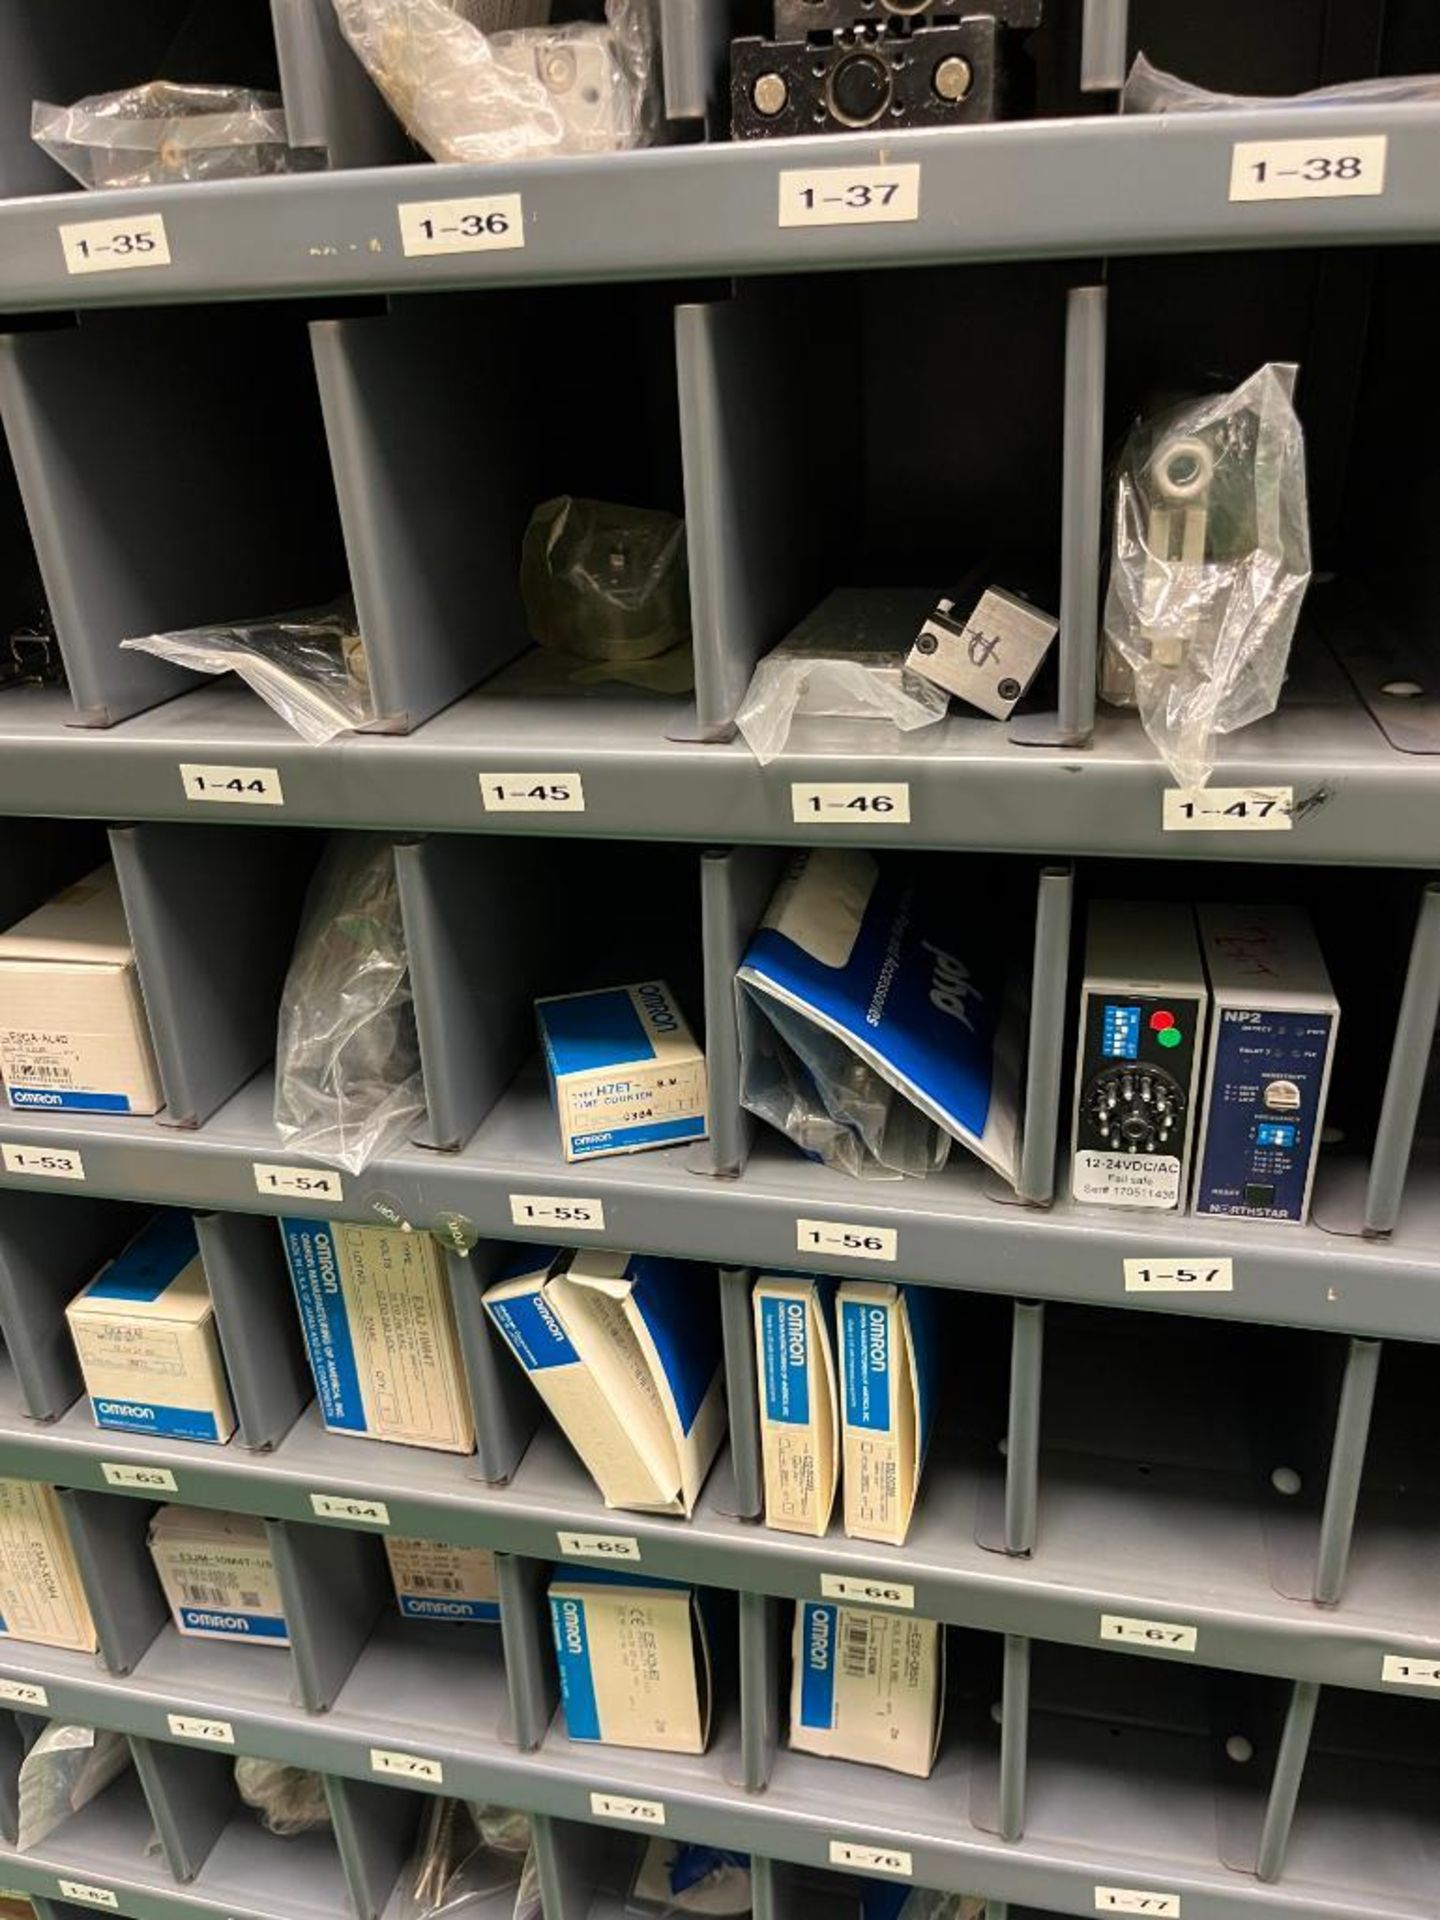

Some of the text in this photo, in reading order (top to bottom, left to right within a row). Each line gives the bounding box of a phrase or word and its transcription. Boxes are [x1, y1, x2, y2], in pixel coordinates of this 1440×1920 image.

[1251, 157, 1363, 184] 1-38
[799, 183, 901, 209] 1-37
[419, 212, 510, 241] 1-36
[75, 232, 156, 258] 1-35
[193, 775, 267, 795] 1-44
[491, 784, 573, 803] 1-45
[807, 794, 895, 813] 1-46
[1178, 798, 1280, 820] 1-47
[638, 985, 678, 1033] OMRON
[1224, 1011, 1262, 1023] NP2
[14, 1091, 63, 1105] OMRON
[604, 1091, 653, 1105] COUNTER
[573, 1132, 613, 1146] OMRON
[13, 1152, 74, 1171] 1-53
[1085, 1157, 1179, 1174] 12-24VDC/AC
[264, 1173, 332, 1193] 1-54
[522, 1204, 592, 1223] 1-55
[1209, 1203, 1289, 1218] NORTHSTAR
[808, 1230, 885, 1252] 1-56
[315, 1233, 338, 1294] OMRON
[1137, 1267, 1220, 1284] 1-57
[531, 1296, 565, 1343] OMRON
[787, 1304, 805, 1367] OMRON
[869, 1308, 885, 1372] OMRON
[98, 1402, 155, 1420] OMRON
[111, 1469, 167, 1486] 1-63
[321, 1501, 379, 1518] 1-64
[570, 1539, 631, 1554] 1-65
[835, 1582, 902, 1602] 1-66
[407, 1600, 473, 1616] OMRON
[186, 1612, 250, 1632] OMRON
[563, 1602, 582, 1653] OMRON
[811, 1609, 828, 1670] OMRON
[1112, 1624, 1185, 1643] 1-67
[176, 1722, 226, 1738] 1-73
[381, 1756, 433, 1775] 1-74
[601, 1800, 657, 1818] 1-75
[842, 1848, 901, 1868] 1-76
[1106, 1894, 1169, 1911] 1-77
